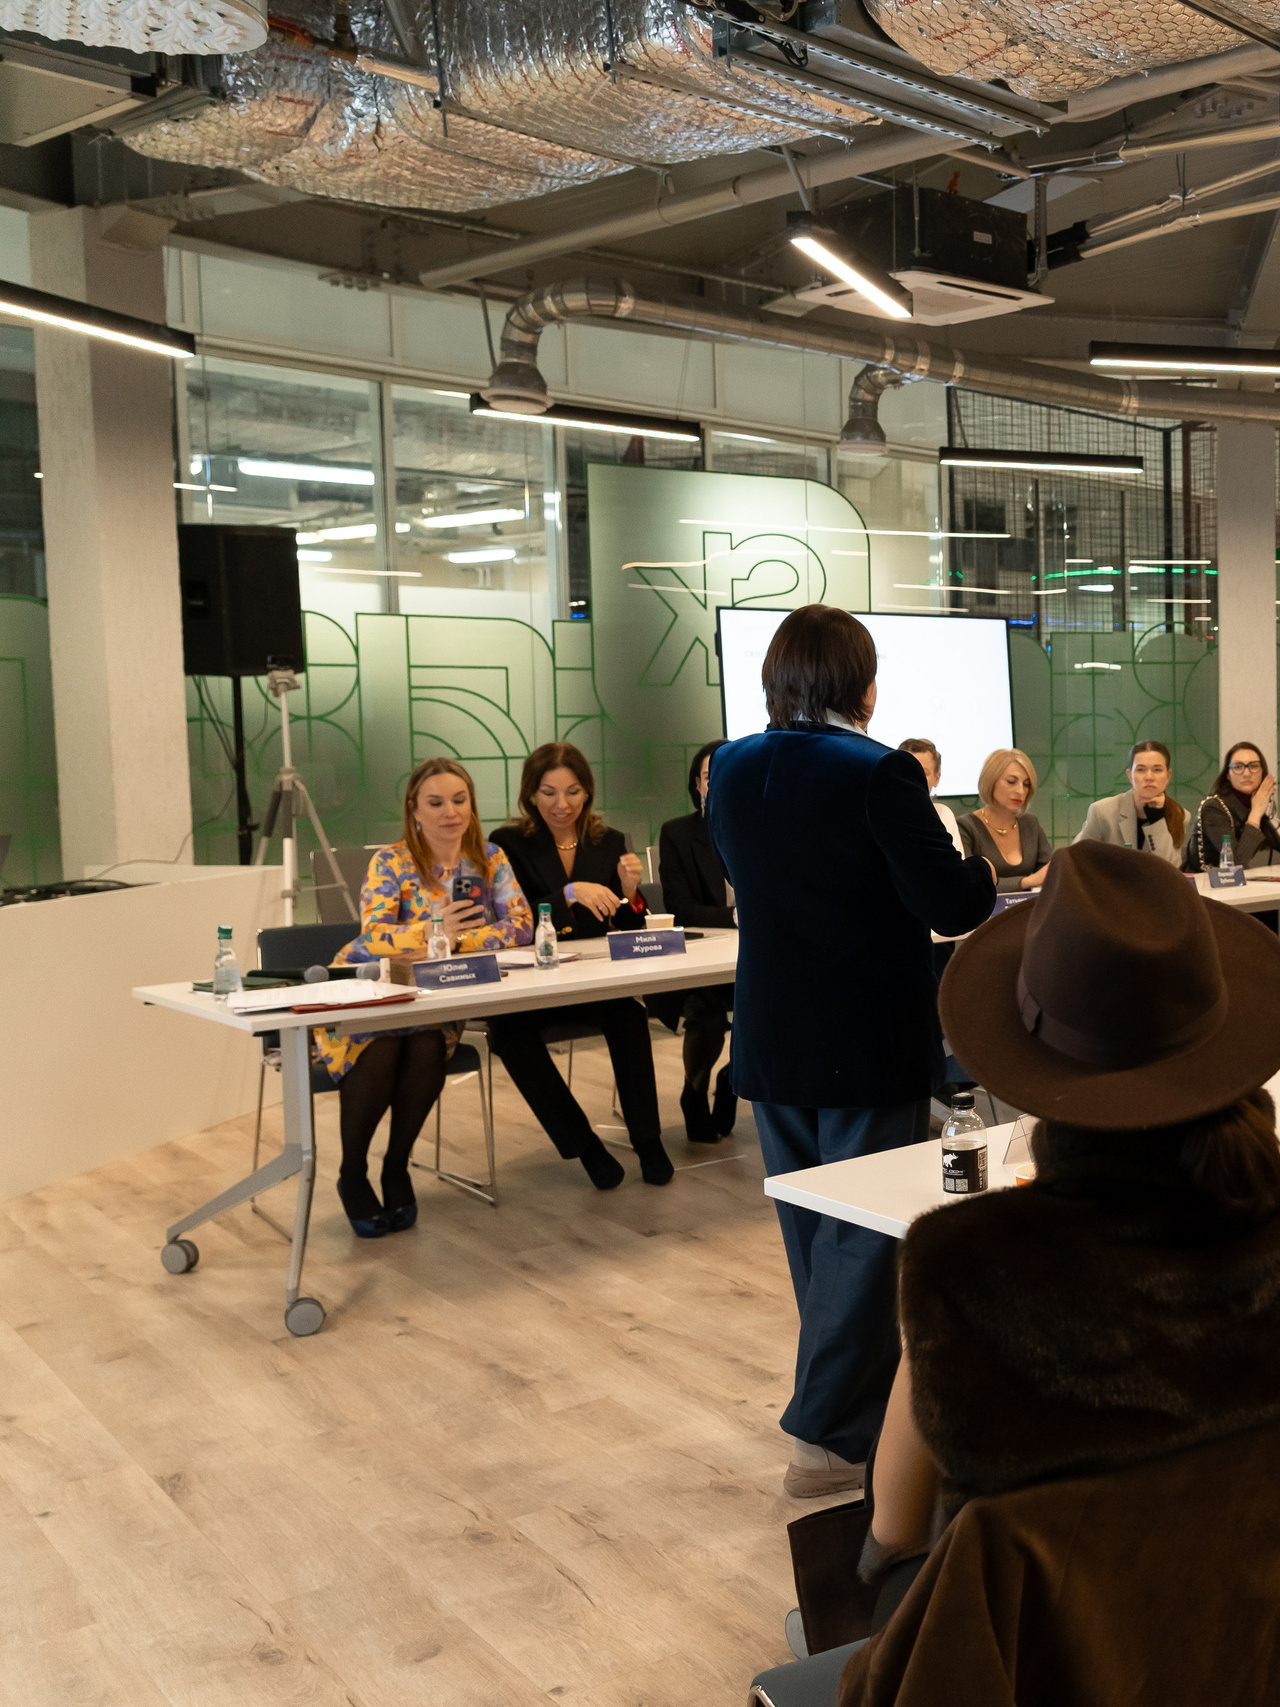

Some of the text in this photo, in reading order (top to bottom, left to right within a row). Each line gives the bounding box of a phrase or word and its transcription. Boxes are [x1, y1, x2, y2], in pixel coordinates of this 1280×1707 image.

[635, 935, 657, 943] Мила
[632, 944, 663, 954] Журова
[443, 963, 468, 972] Юлия
